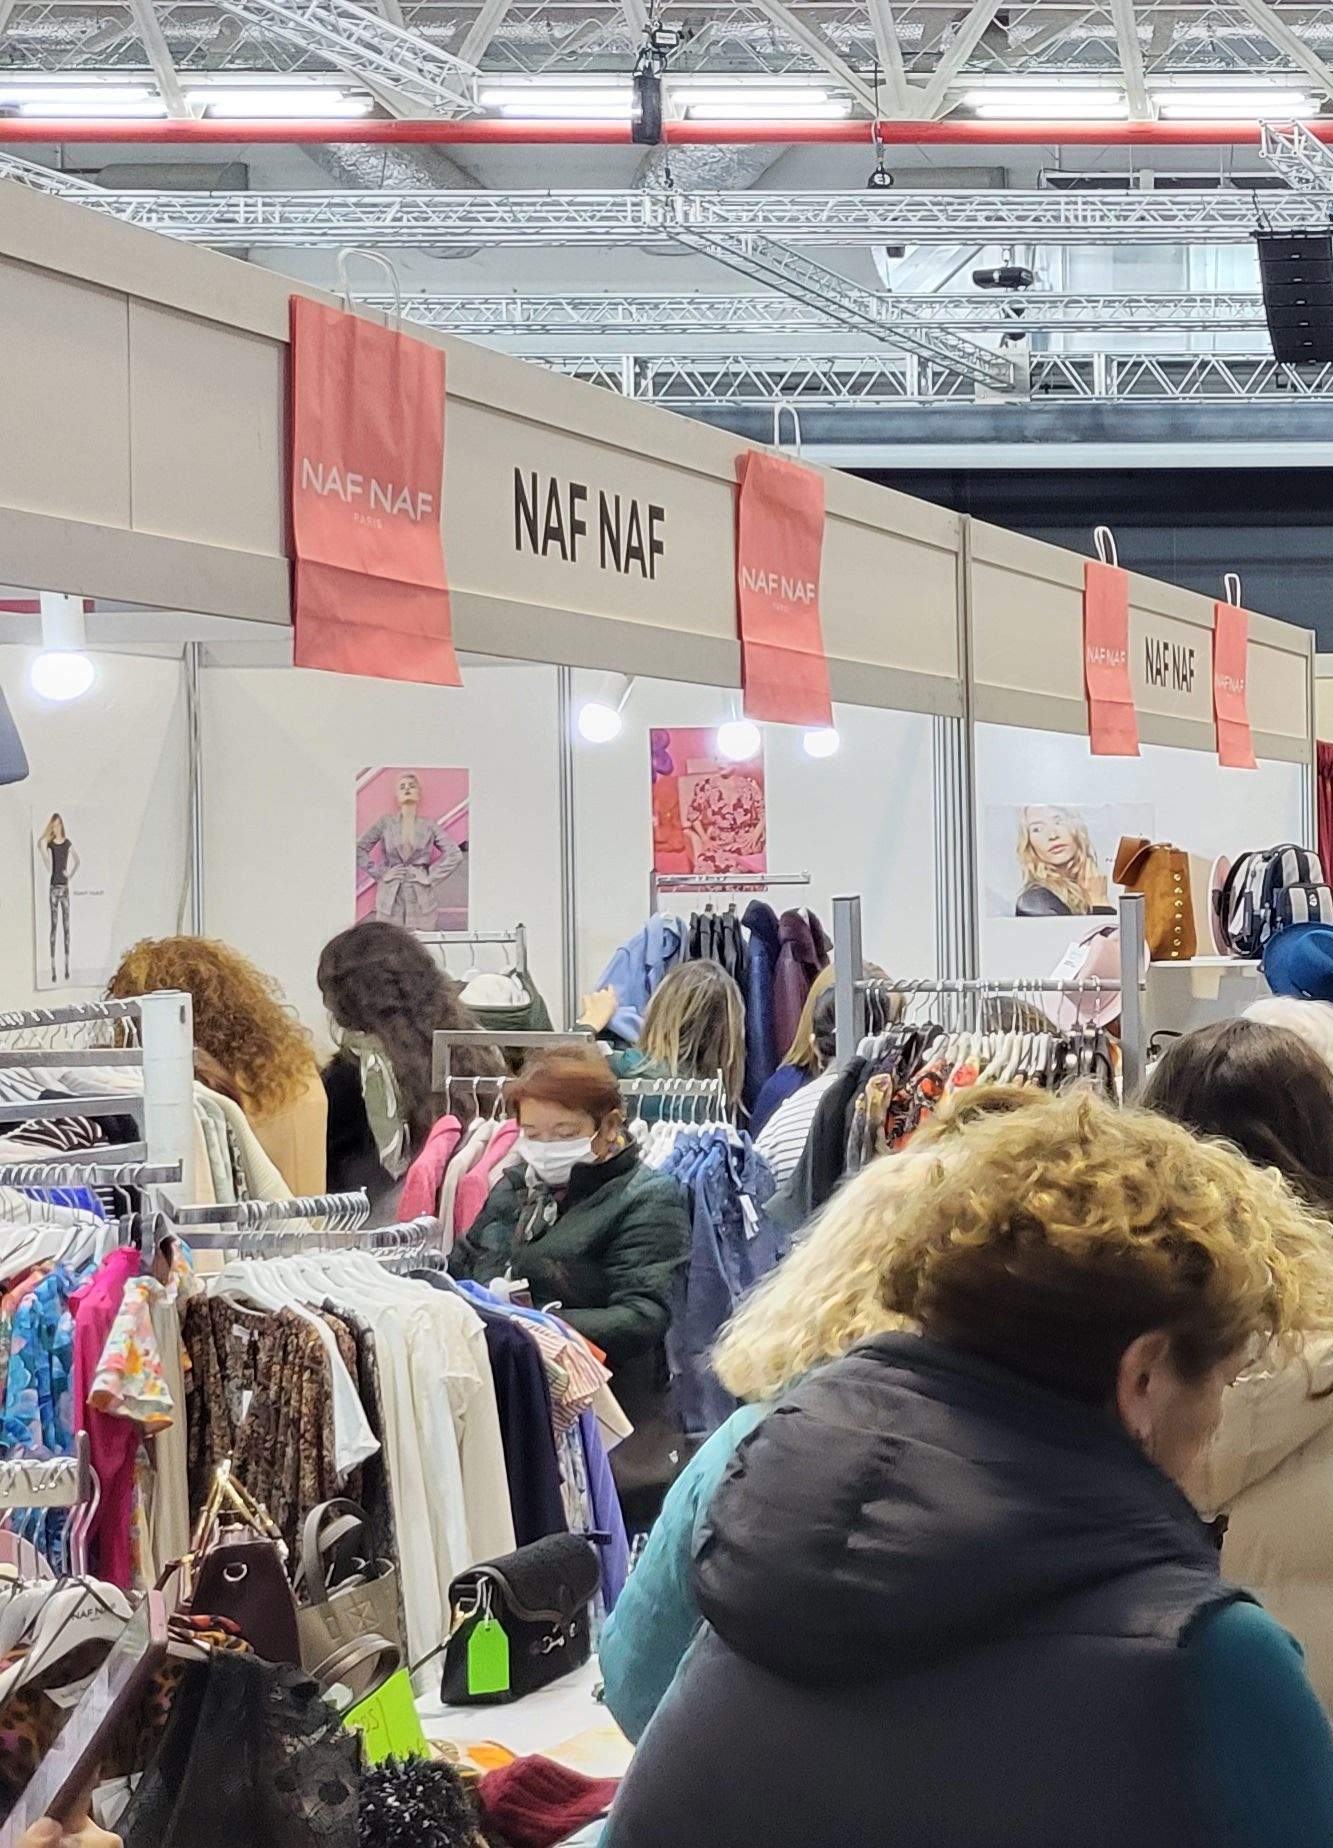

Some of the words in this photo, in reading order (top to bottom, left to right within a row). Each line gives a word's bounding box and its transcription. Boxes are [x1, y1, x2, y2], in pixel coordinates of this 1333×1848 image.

[302, 457, 363, 502] NAF
[370, 478, 433, 521] NAF
[514, 467, 587, 562] NAF
[599, 490, 665, 579] NAF
[742, 566, 778, 595] NAF
[781, 575, 815, 605] NAF
[1087, 646, 1105, 664] NAF
[1106, 648, 1126, 667] NAF
[1145, 636, 1168, 687] NAF
[1172, 644, 1194, 692] NAF
